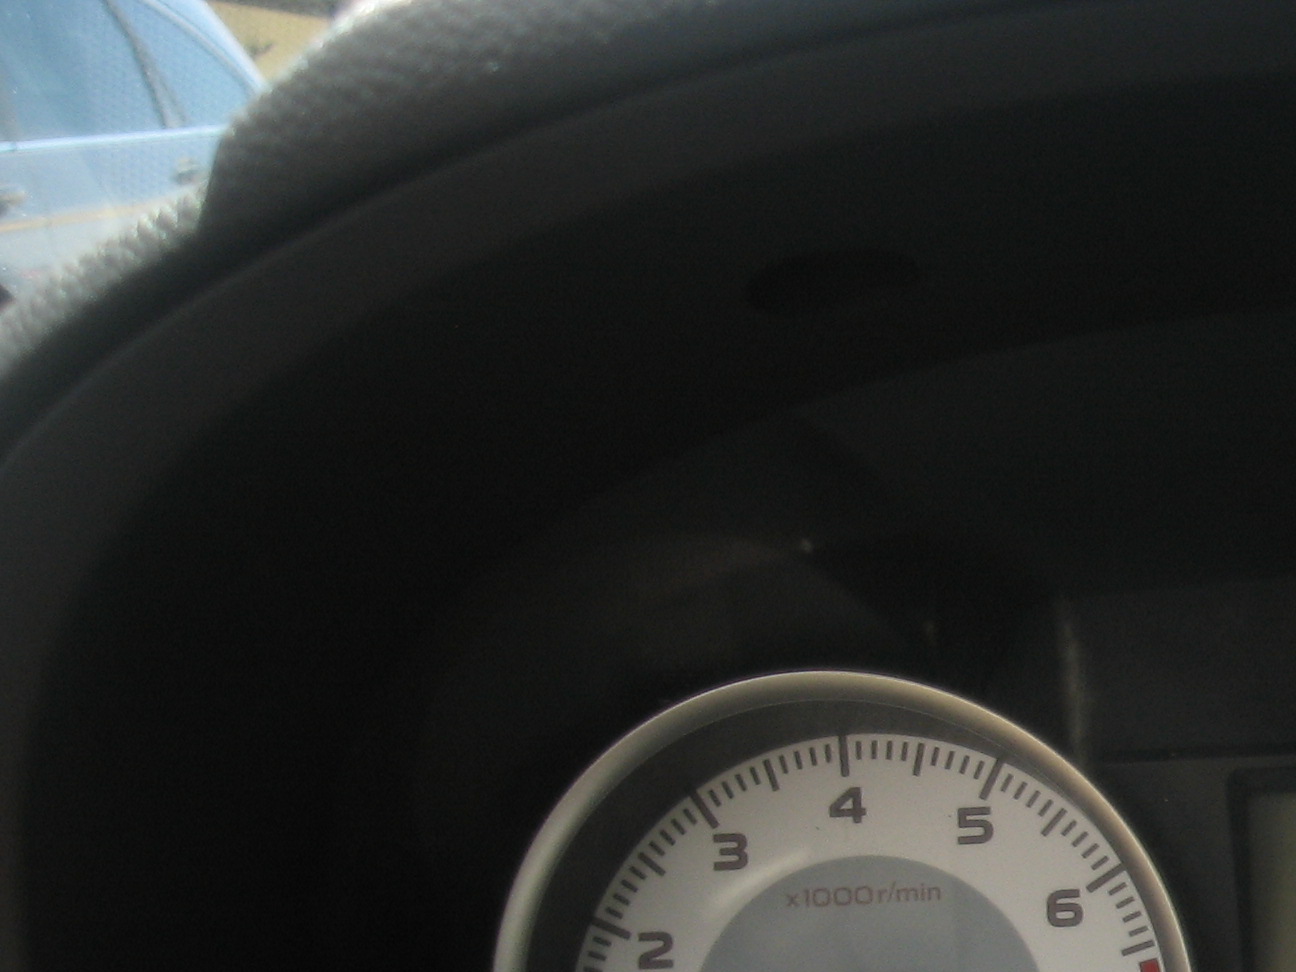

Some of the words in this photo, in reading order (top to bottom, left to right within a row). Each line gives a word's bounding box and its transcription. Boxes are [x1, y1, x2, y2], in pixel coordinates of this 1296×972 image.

[829, 786, 867, 824] 4
[957, 806, 994, 845] 5
[713, 832, 749, 871] 3
[1046, 888, 1084, 928] 6
[637, 931, 674, 970] 2
